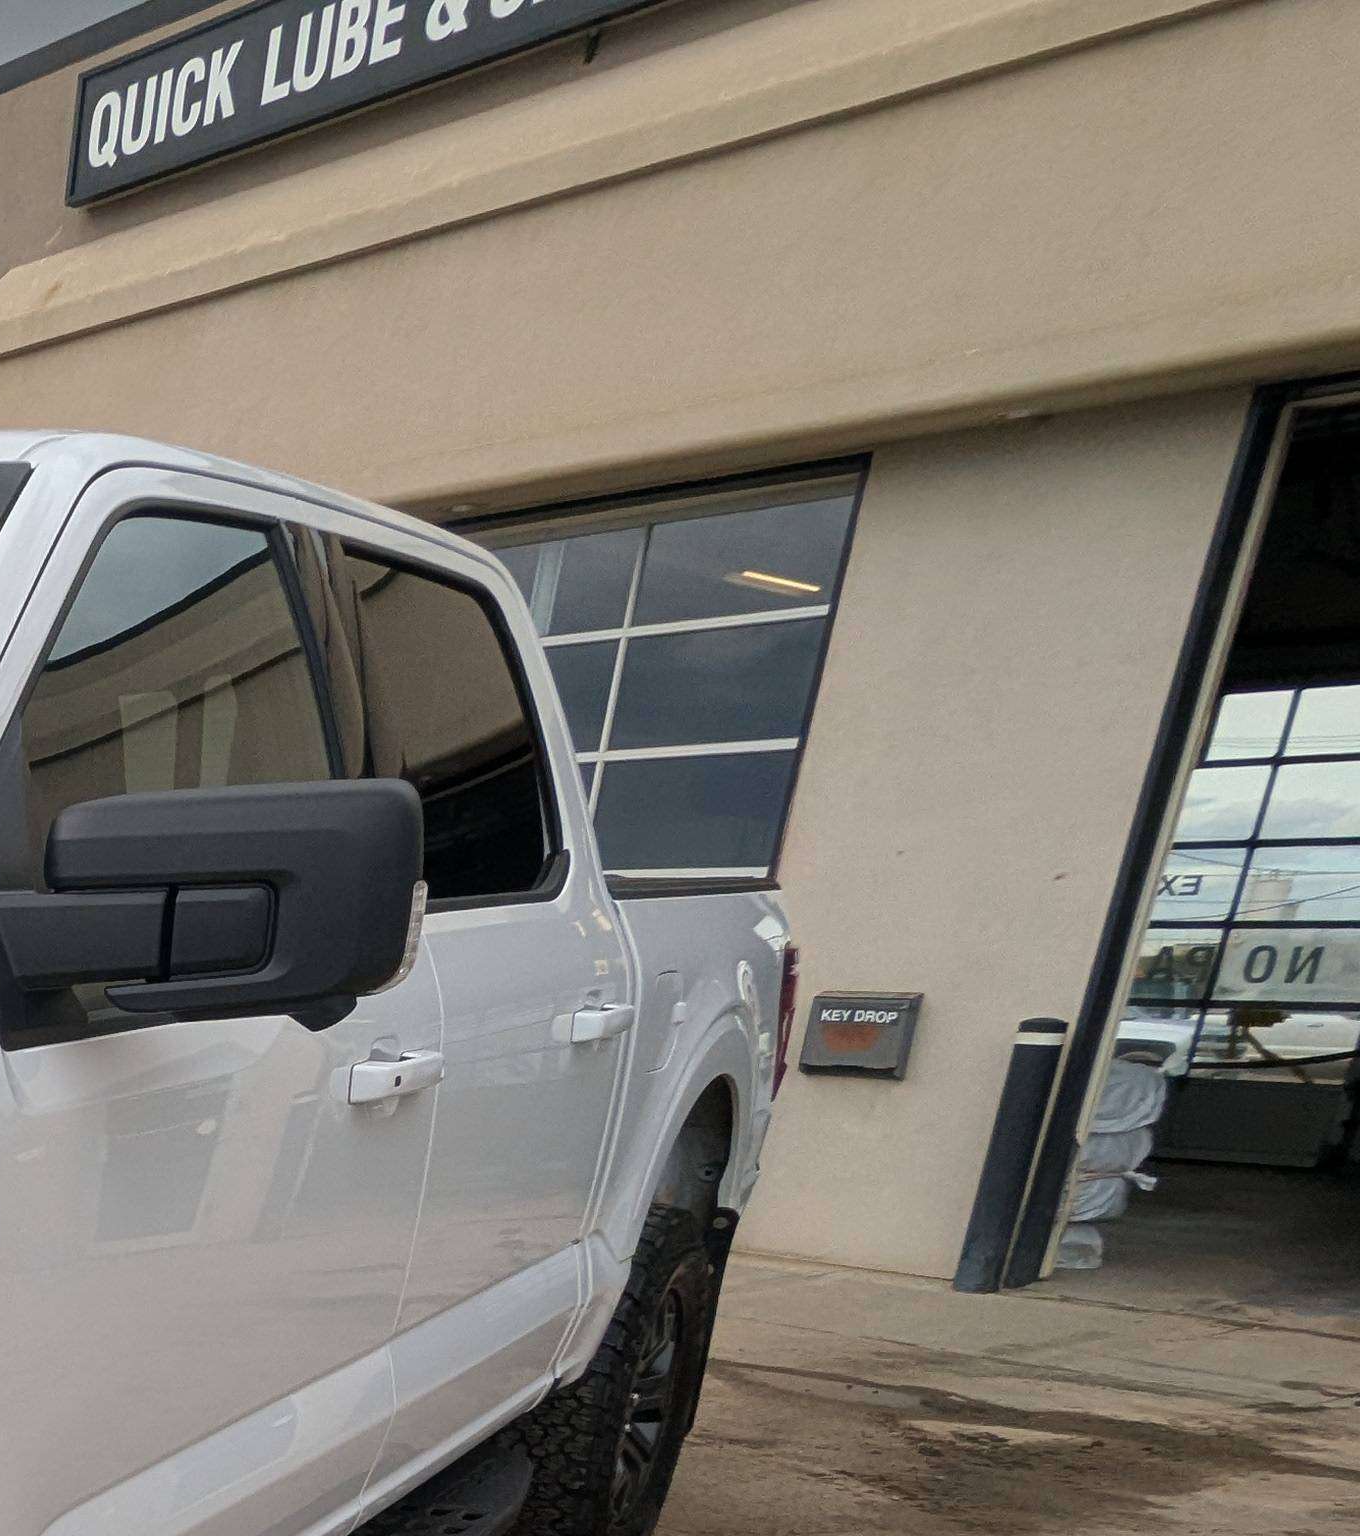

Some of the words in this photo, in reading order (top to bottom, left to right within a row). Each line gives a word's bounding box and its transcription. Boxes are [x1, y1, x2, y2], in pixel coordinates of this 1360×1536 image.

[88, 40, 244, 169] QUICK
[260, 0, 406, 106] LUBE
[820, 1009, 853, 1022] KEY
[853, 1010, 899, 1024] DROP
